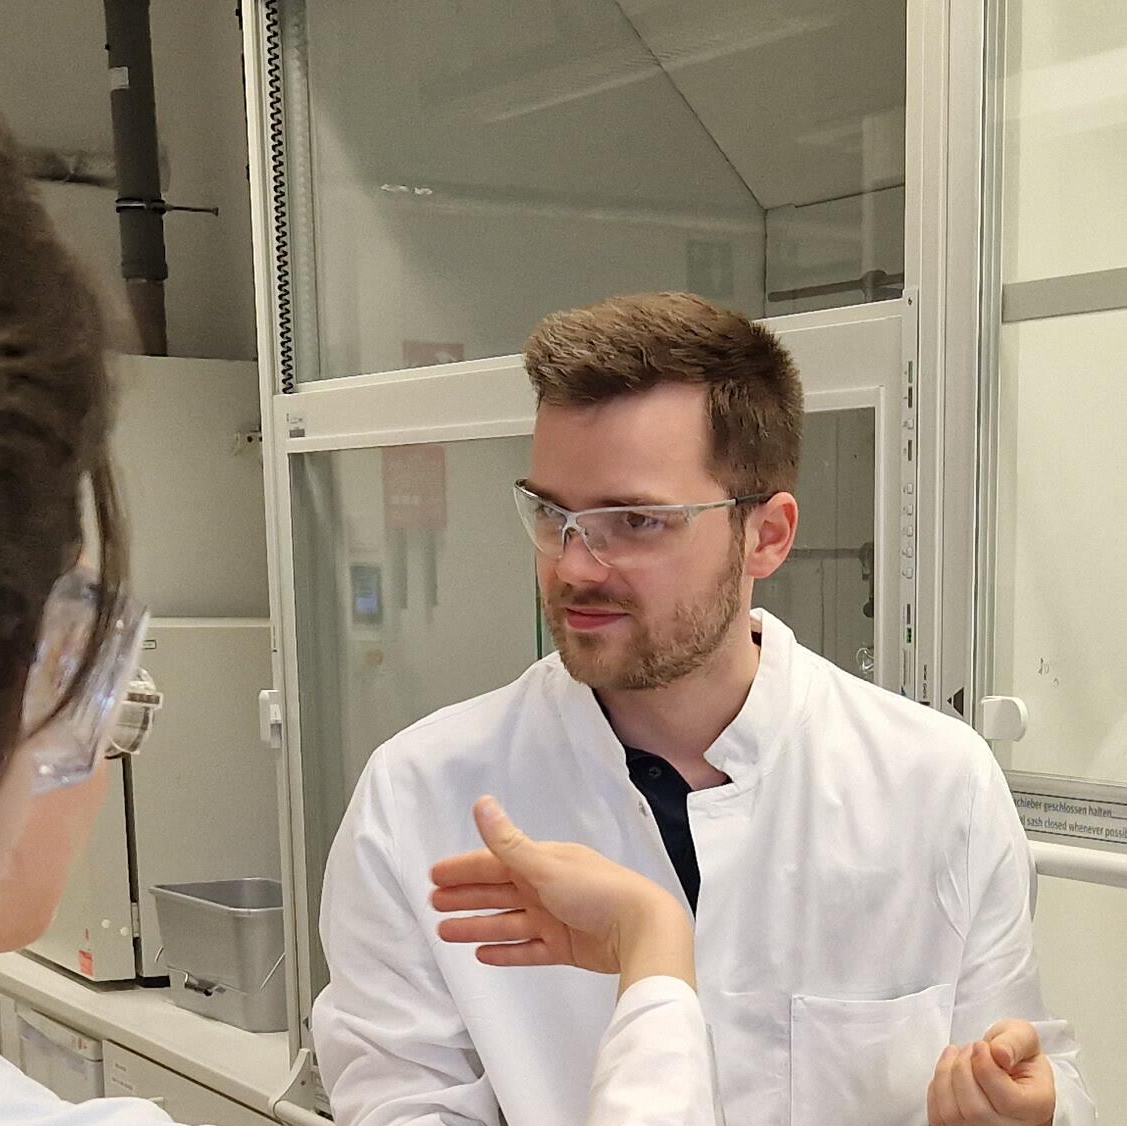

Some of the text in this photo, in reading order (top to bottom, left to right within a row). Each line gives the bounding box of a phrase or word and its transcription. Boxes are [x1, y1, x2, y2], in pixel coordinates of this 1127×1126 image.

[1043, 801, 1087, 815] geschlossen
[1088, 805, 1112, 817] halten
[1027, 816, 1043, 827] sash
[1044, 818, 1067, 830] closed
[1068, 821, 1103, 835] whenever
